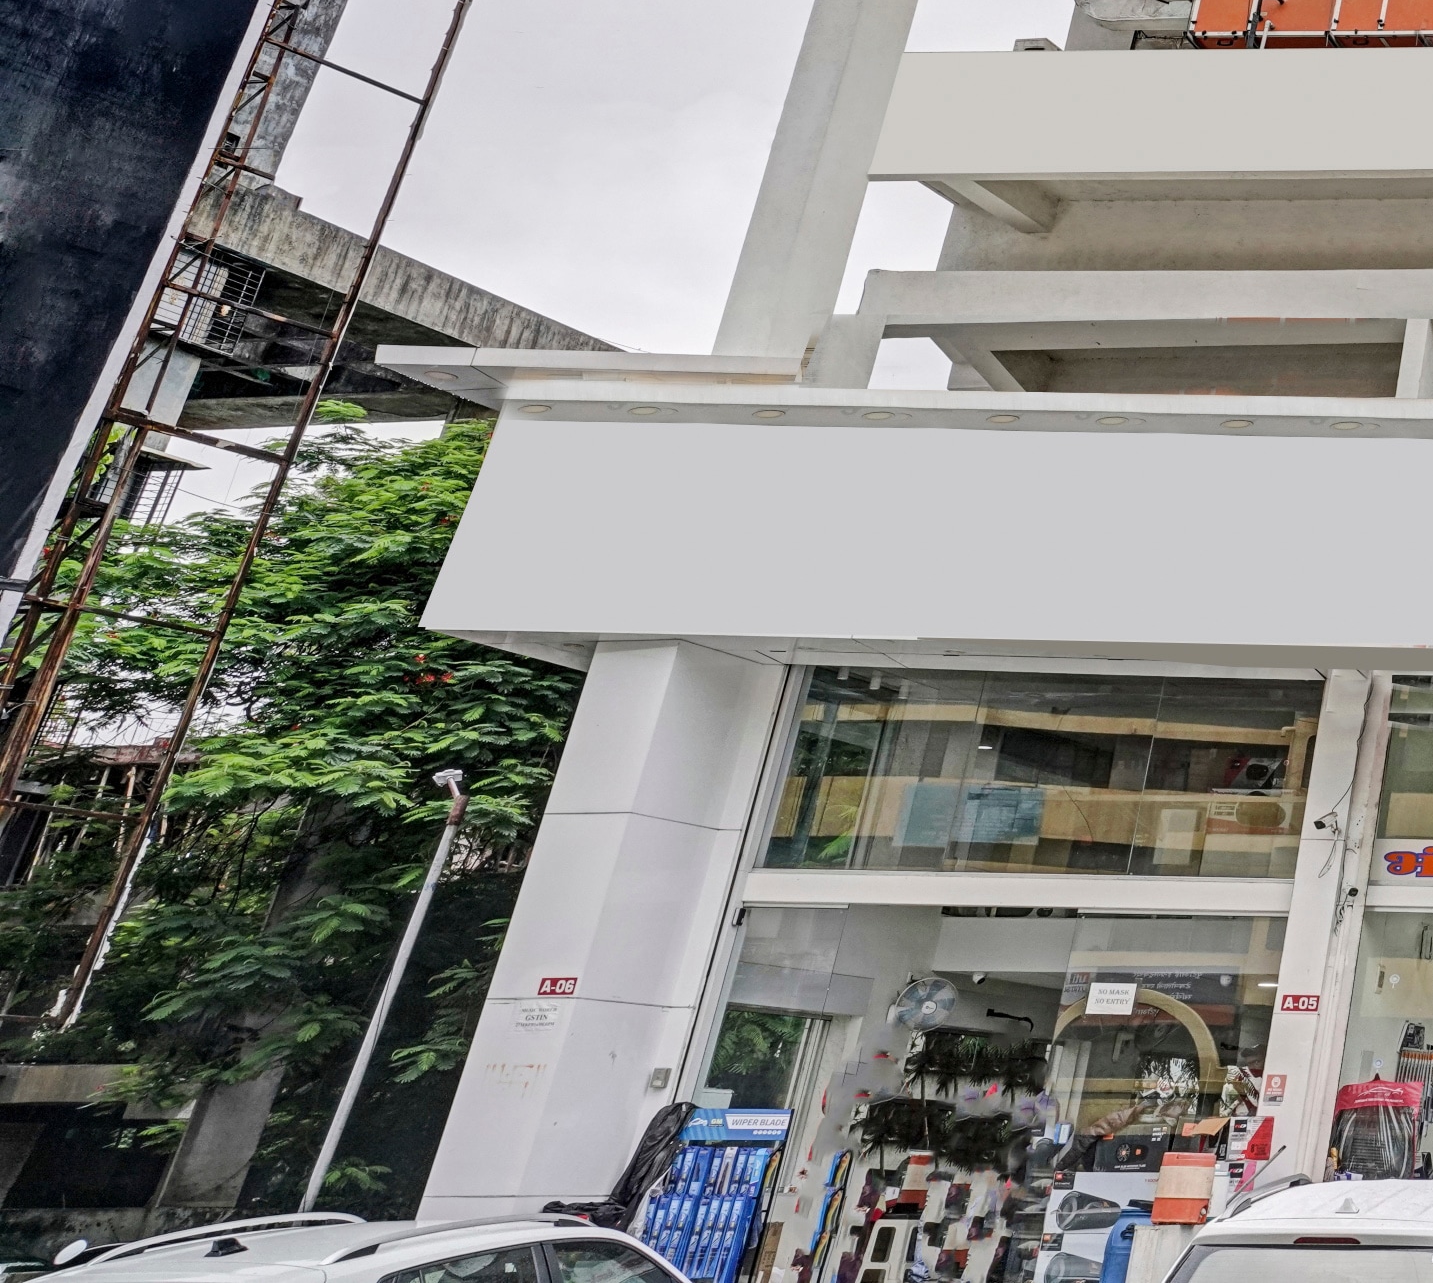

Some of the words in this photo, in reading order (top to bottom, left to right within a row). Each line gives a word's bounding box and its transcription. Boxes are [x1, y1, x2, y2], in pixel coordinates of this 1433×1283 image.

[540, 979, 576, 993] A-06
[1109, 988, 1131, 996] MASK
[1094, 997, 1105, 1005] NO
[1106, 997, 1131, 1005] ENTRY
[1282, 997, 1318, 1009] A-05
